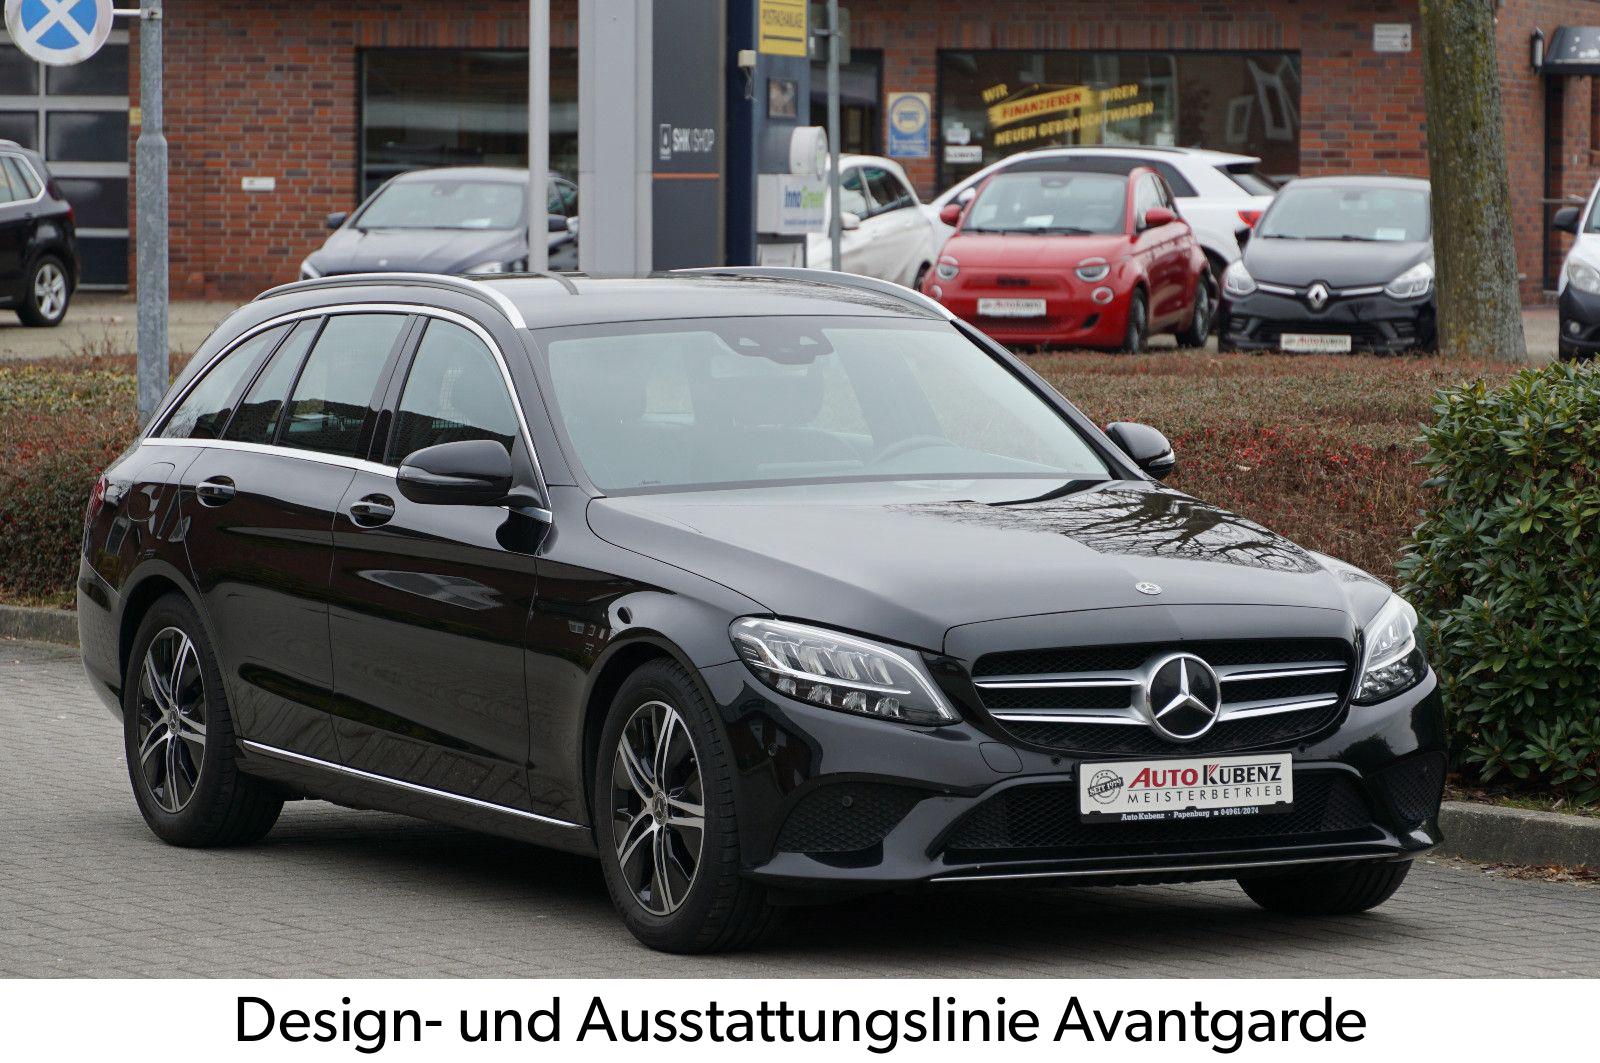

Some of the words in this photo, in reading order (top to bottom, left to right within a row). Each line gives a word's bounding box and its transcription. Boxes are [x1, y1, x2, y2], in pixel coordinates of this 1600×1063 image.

[981, 84, 1008, 103] WIR
[1001, 92, 1082, 119] FINANZIEREN
[993, 126, 1037, 147] NEUEN
[1128, 767, 1199, 789] AUTO
[1203, 763, 1282, 786] KUBENZ
[1127, 785, 1283, 804] MEISTERBETRIEB
[1173, 810, 1210, 819] Papenburg
